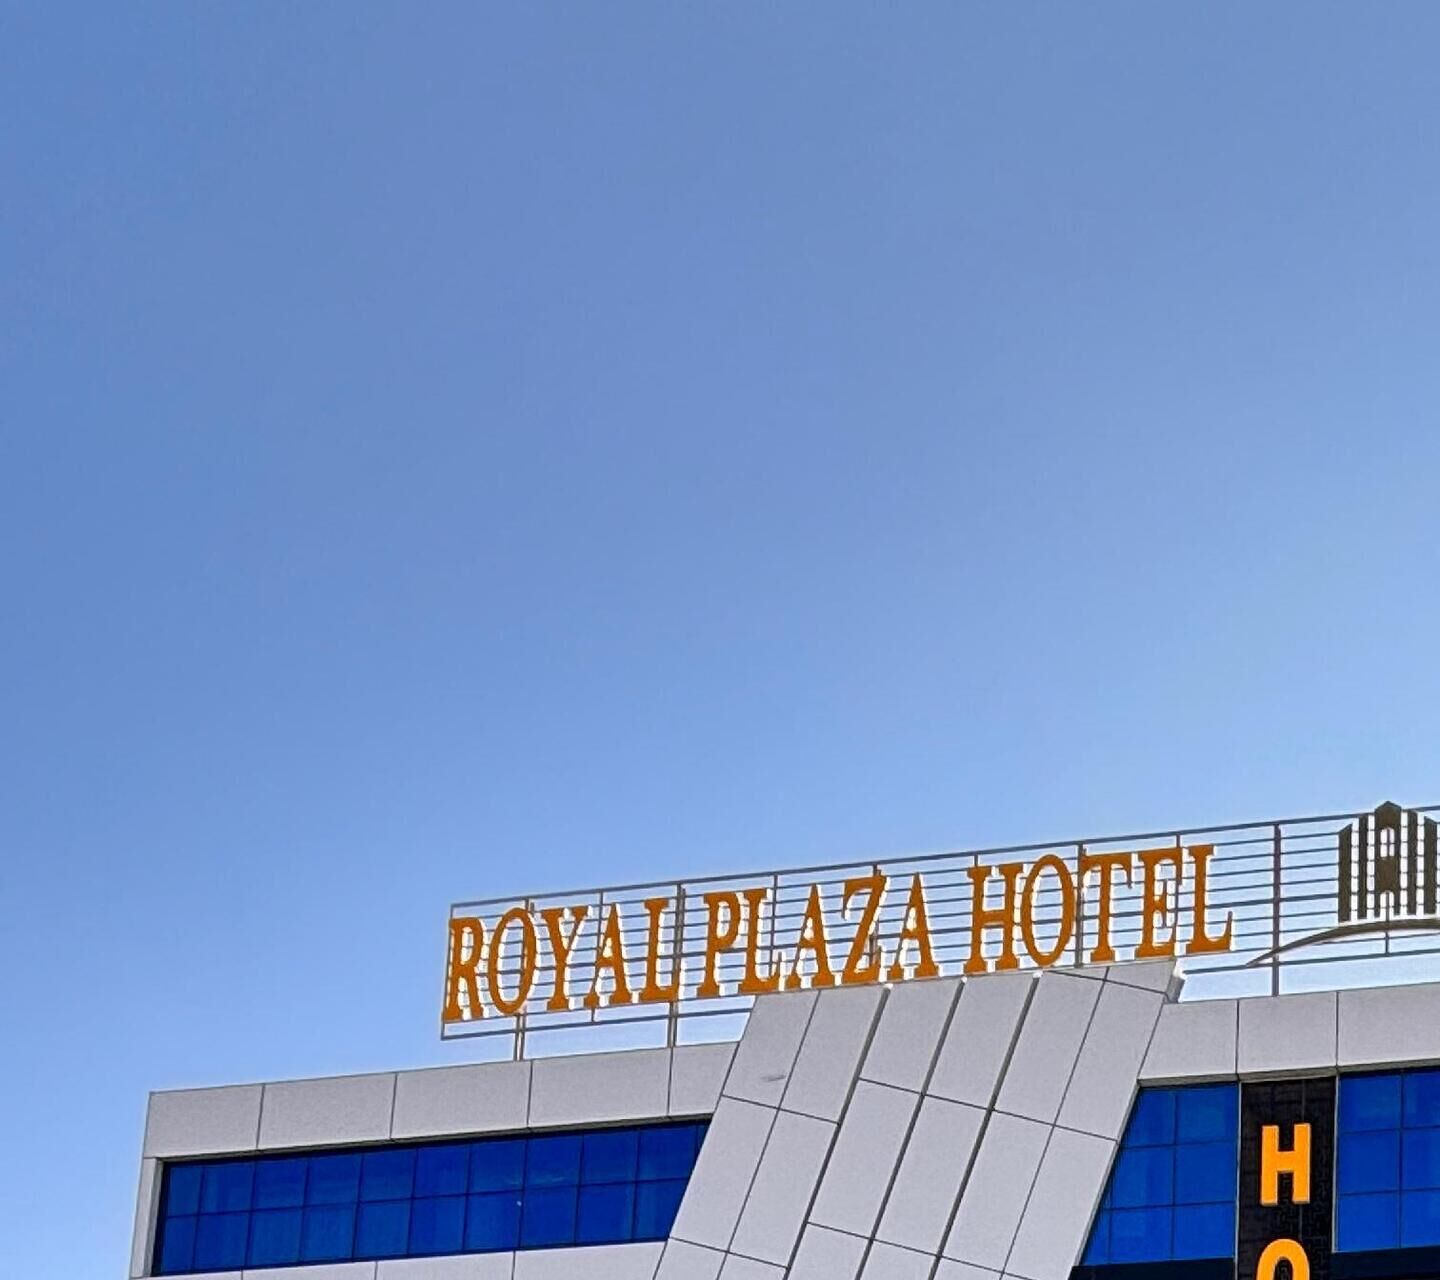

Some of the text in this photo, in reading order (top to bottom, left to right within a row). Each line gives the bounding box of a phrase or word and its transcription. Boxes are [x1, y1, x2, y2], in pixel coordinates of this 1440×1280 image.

[443, 844, 1233, 1024] ROYAL PLAZA HOTEL
